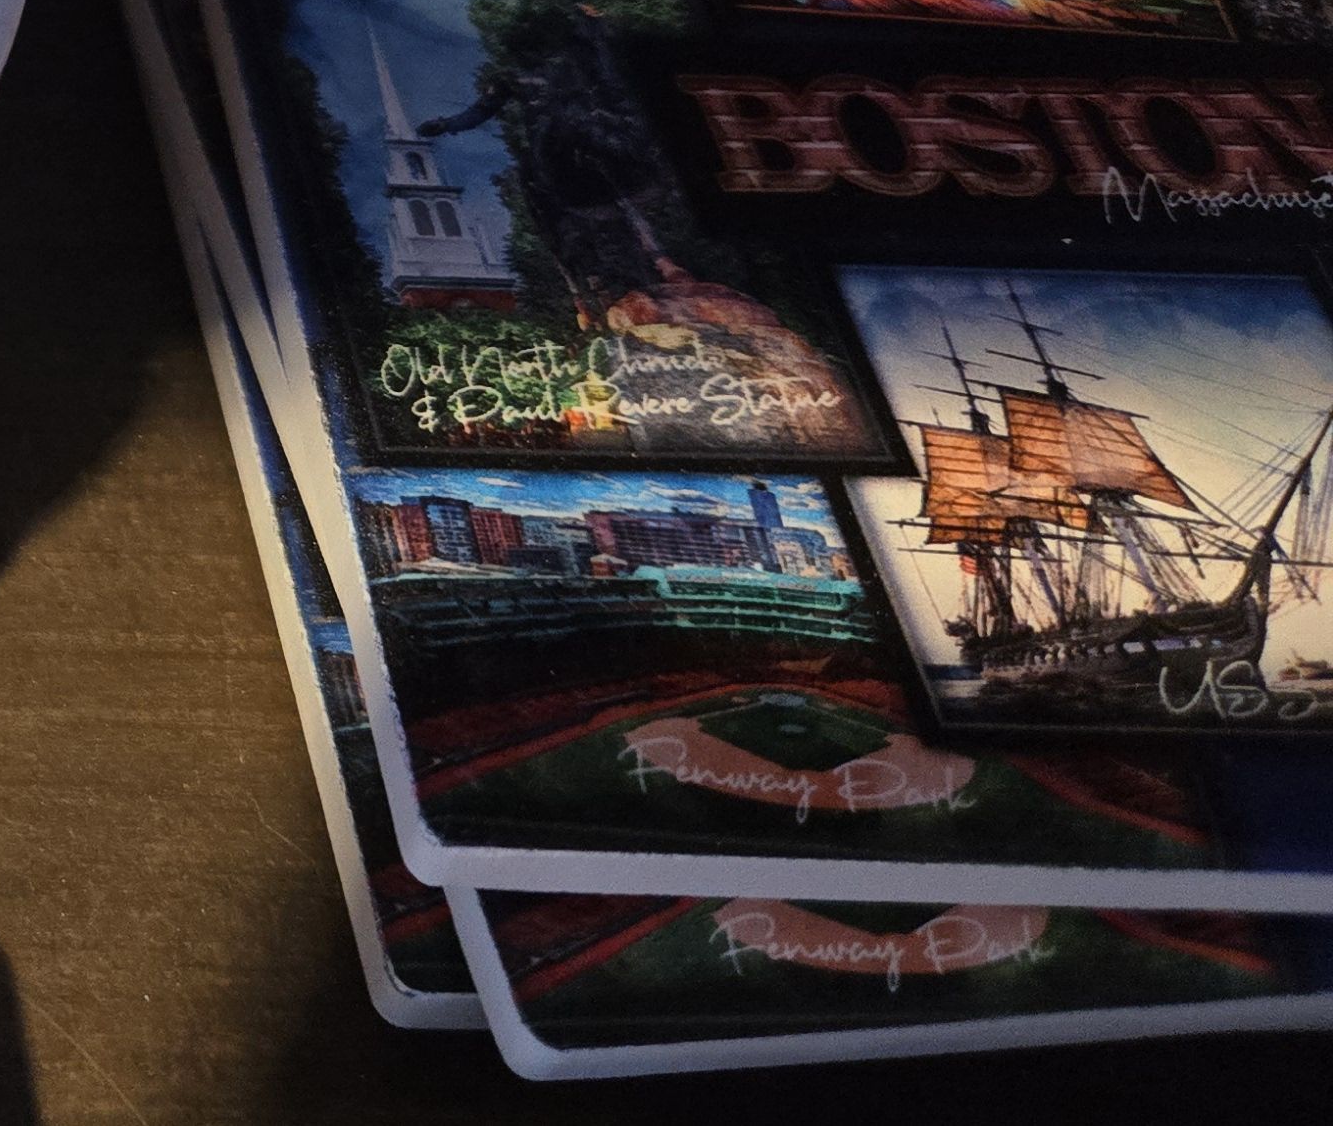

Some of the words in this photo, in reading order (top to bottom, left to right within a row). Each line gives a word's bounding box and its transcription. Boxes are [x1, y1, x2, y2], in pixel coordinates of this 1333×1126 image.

[678, 73, 1333, 197] BOSTON
[380, 343, 452, 397] Old
[452, 339, 579, 396] North
[446, 384, 563, 435] Paul
[569, 381, 694, 429] Revere
[699, 372, 842, 426] Statue
[617, 735, 818, 824] Fenway
[834, 758, 977, 813] Park
[708, 911, 906, 993] Fenway
[913, 914, 1056, 975] Park
